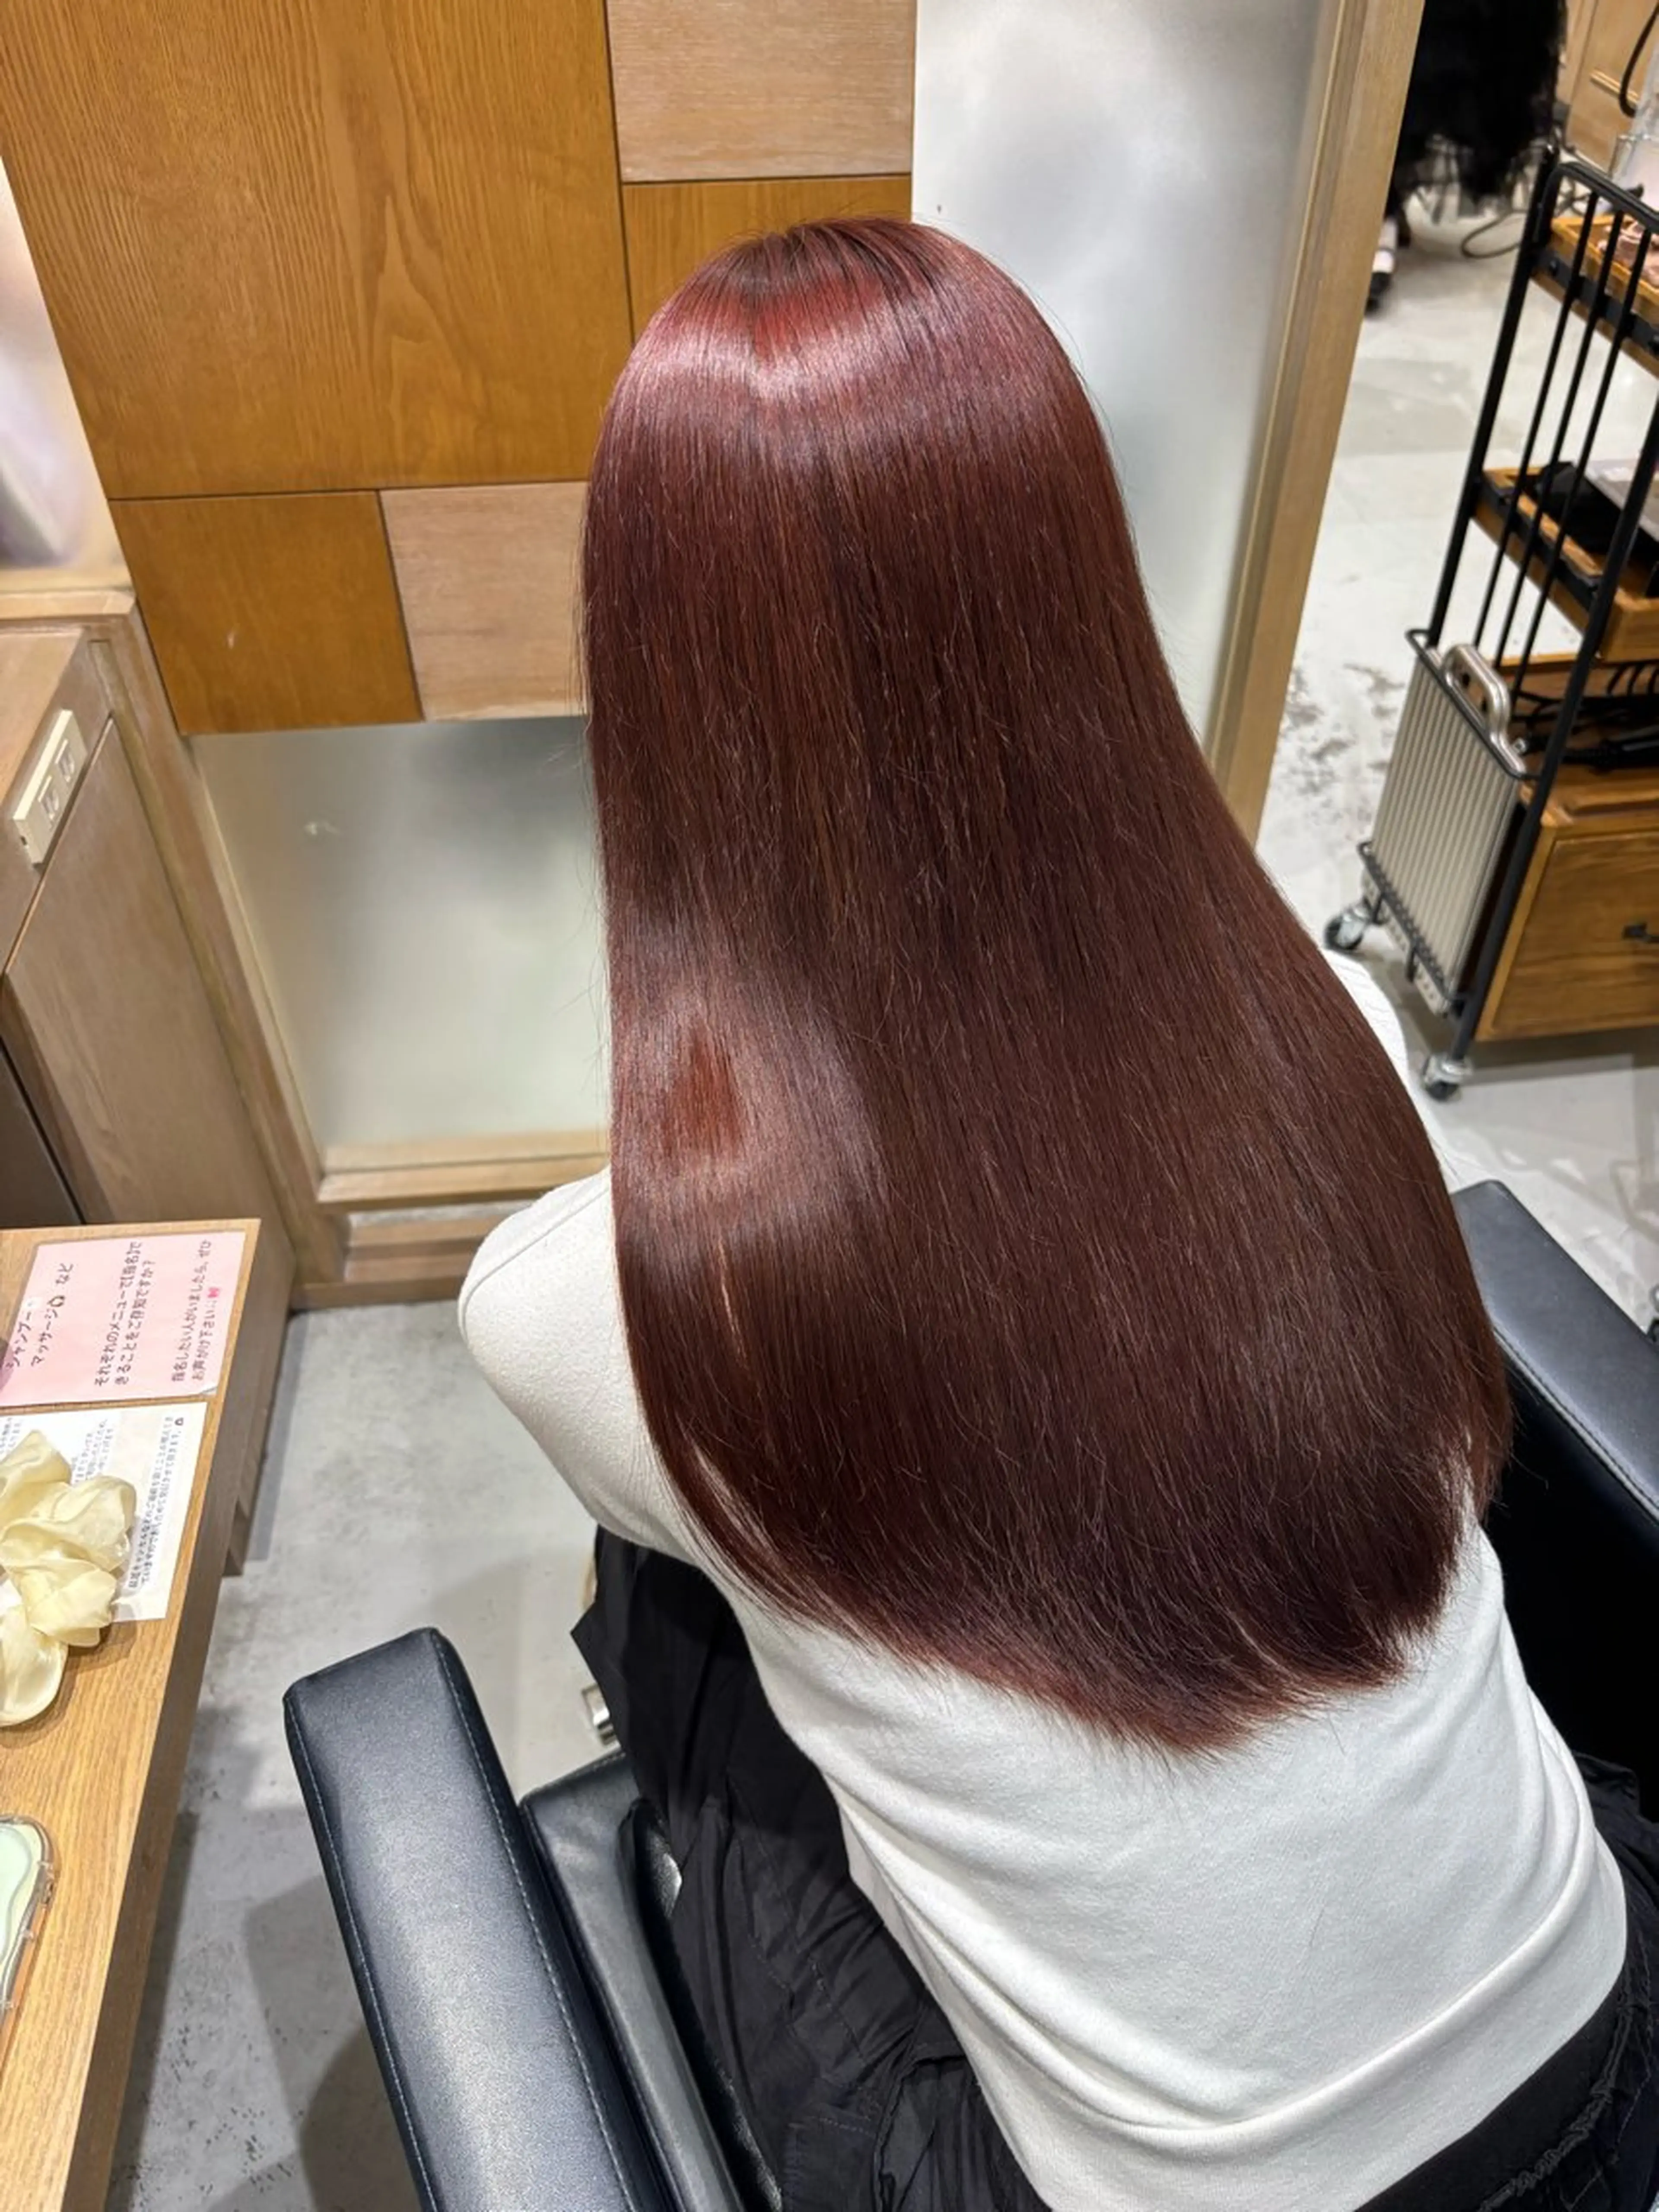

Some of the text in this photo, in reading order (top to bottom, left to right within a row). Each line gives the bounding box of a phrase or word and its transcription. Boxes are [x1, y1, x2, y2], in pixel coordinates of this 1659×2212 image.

[31, 1308, 58, 1367] マッサージ
